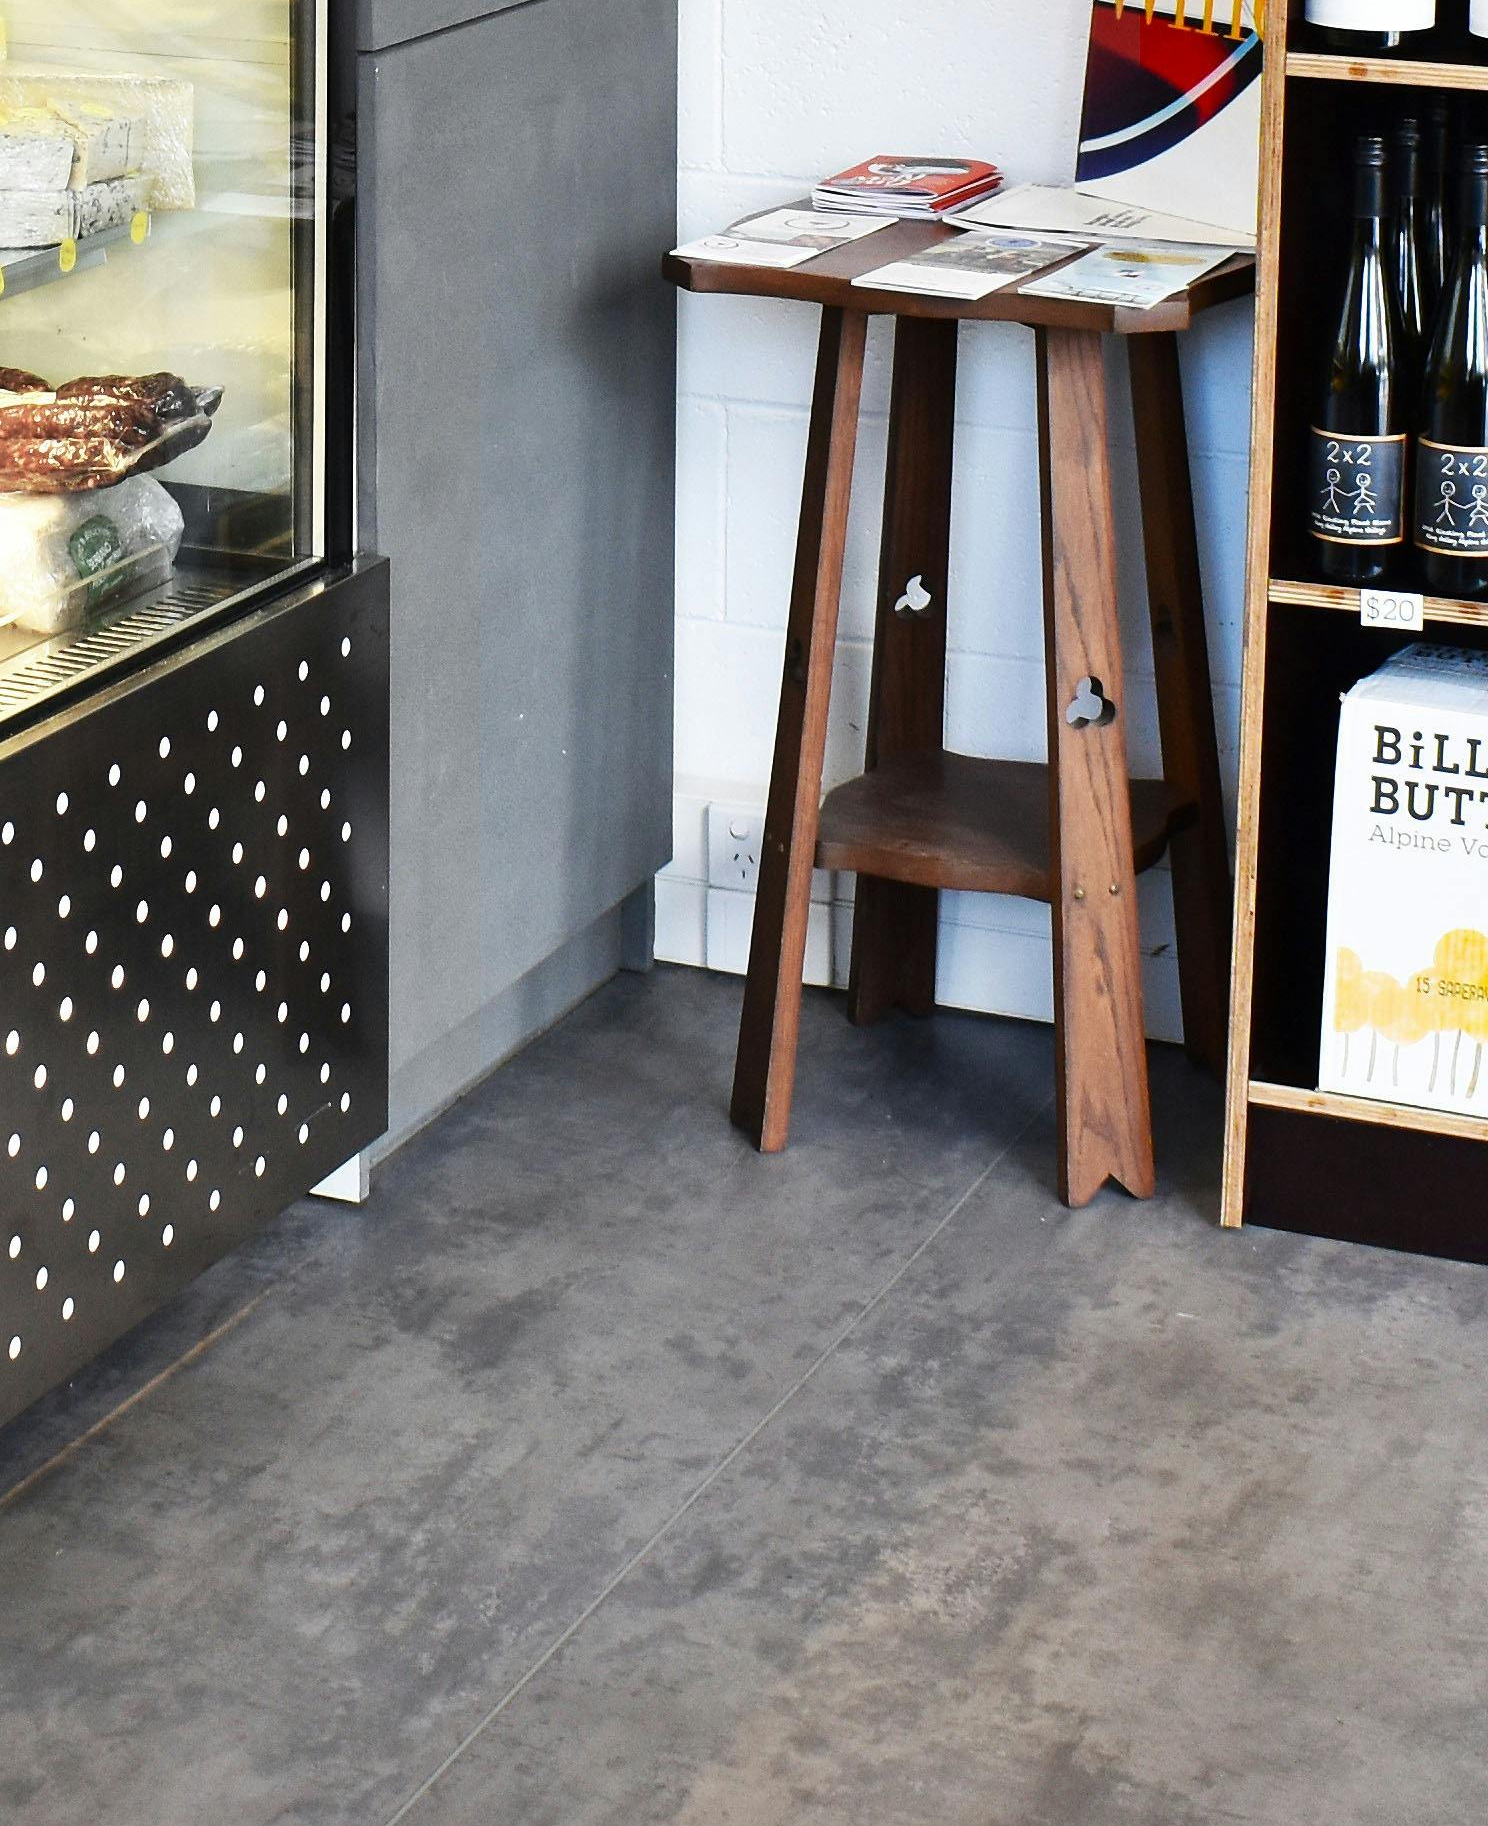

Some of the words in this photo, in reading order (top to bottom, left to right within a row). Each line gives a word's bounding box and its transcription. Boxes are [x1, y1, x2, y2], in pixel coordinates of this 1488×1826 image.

[1366, 597, 1416, 623] $20
[1367, 823, 1452, 853] Alpine
[1415, 976, 1431, 995] 15
